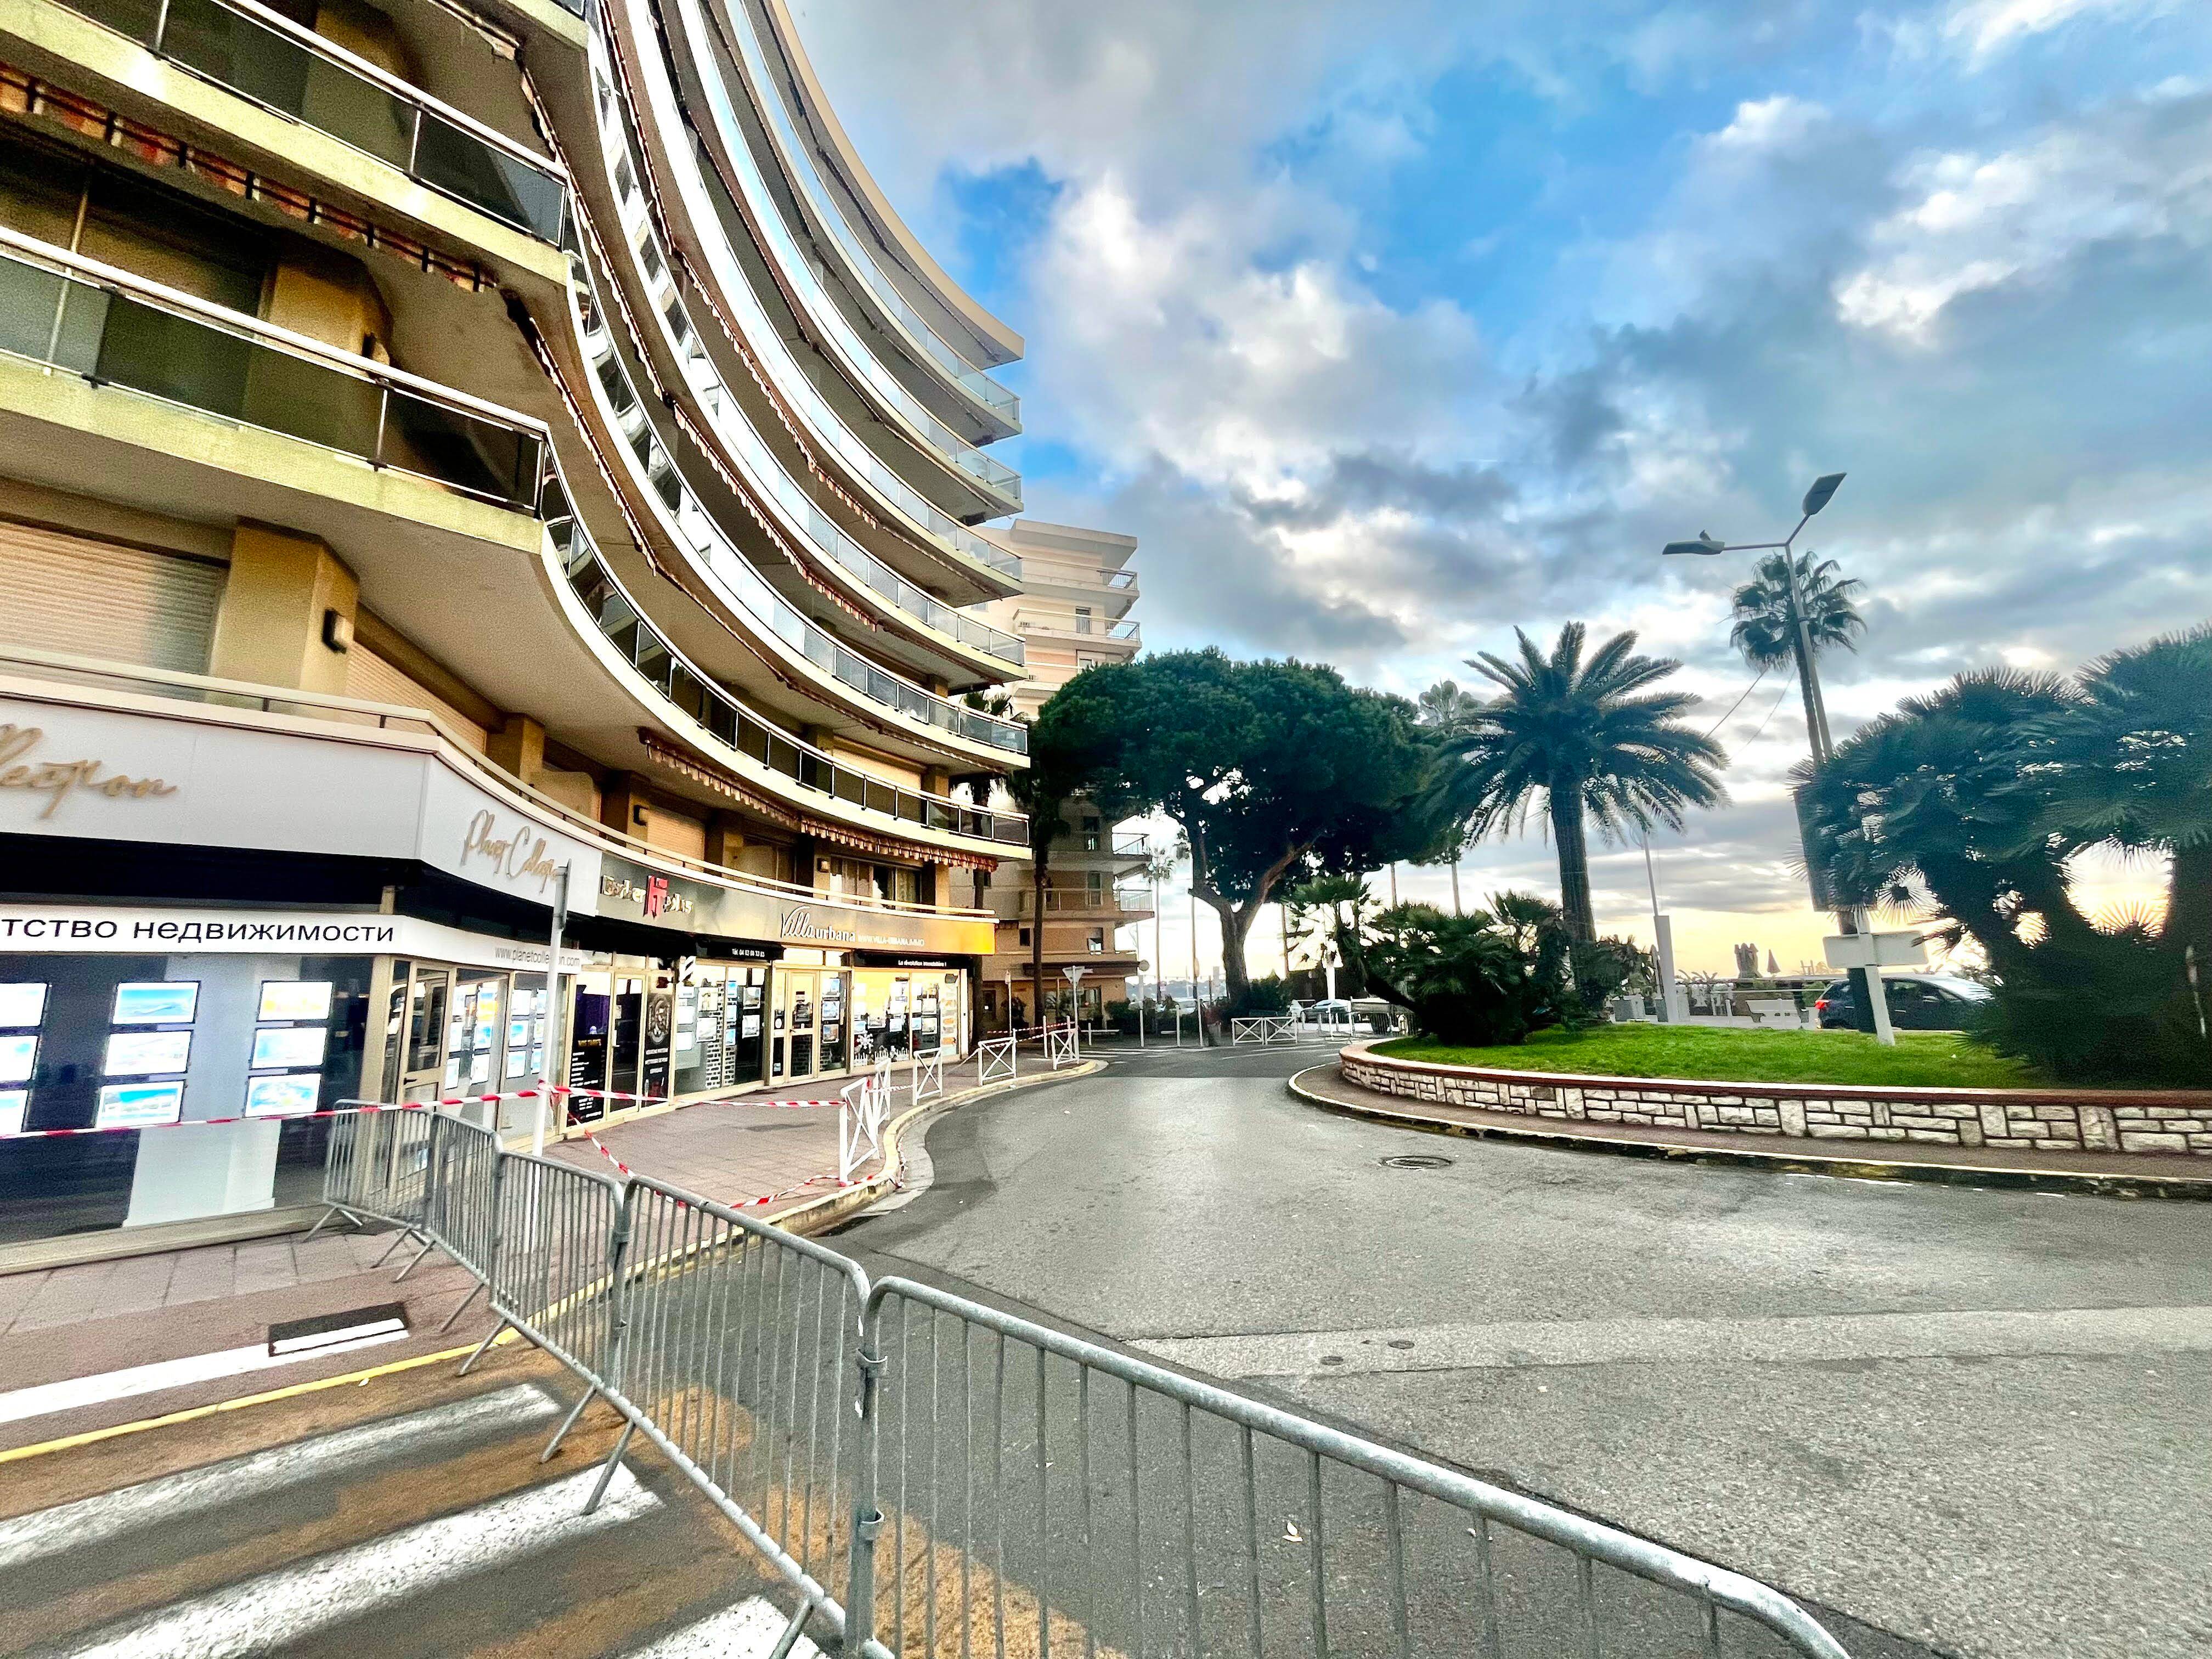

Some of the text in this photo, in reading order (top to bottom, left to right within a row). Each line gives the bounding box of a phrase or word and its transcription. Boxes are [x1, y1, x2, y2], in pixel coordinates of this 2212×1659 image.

[133, 922, 393, 943] недвижимости
[780, 905, 815, 939] Villa
[814, 925, 856, 942] urbana
[495, 946, 580, 966] www.planetcollen.com
